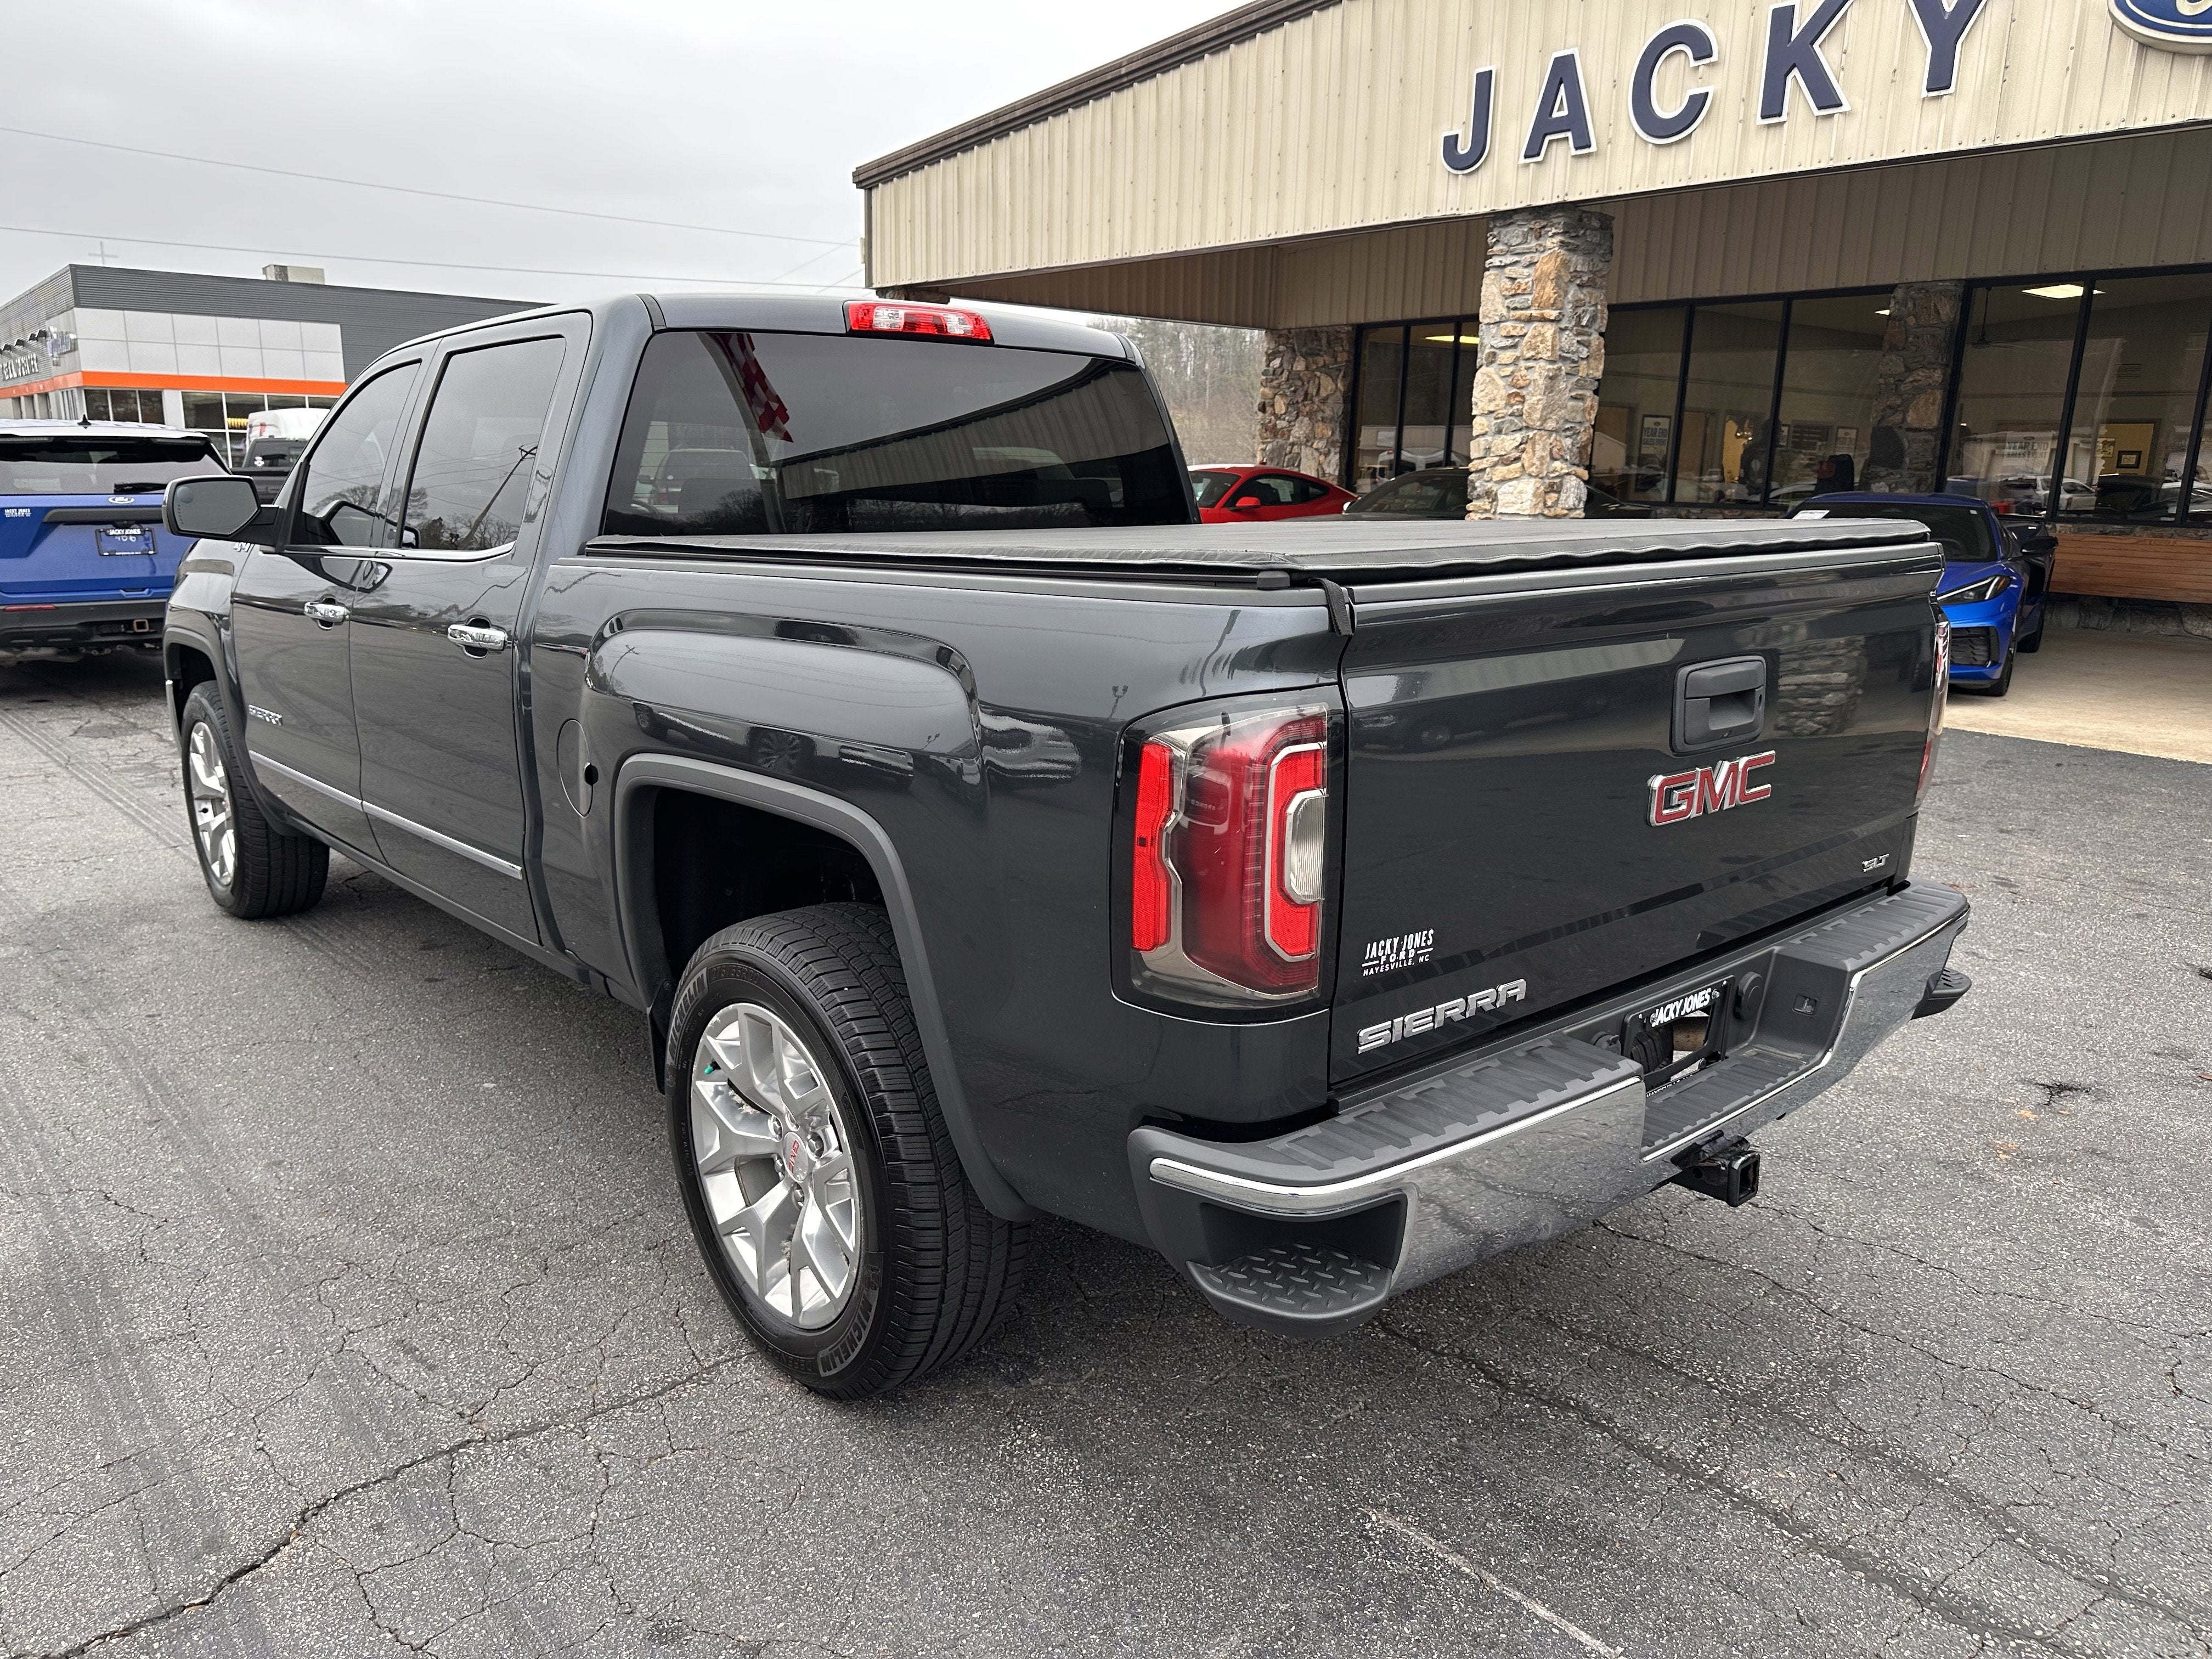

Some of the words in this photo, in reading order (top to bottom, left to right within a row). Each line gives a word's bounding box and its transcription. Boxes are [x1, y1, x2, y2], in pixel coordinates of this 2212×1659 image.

[1441, 0, 1988, 174] JACKY
[1647, 750, 1775, 827] GMC
[1862, 853, 1889, 872] SLT
[1364, 936, 1400, 960] JACKY
[1402, 929, 1434, 951] JONES
[1380, 949, 1415, 964] FORD
[1419, 955, 1430, 963] NC
[668, 973, 707, 1062] MICHELIN
[1356, 978, 1527, 1054] SIERRA
[1651, 998, 1684, 1028] JACKY
[1680, 988, 1712, 1015] JONES
[820, 1292, 873, 1373] MICHELIN
